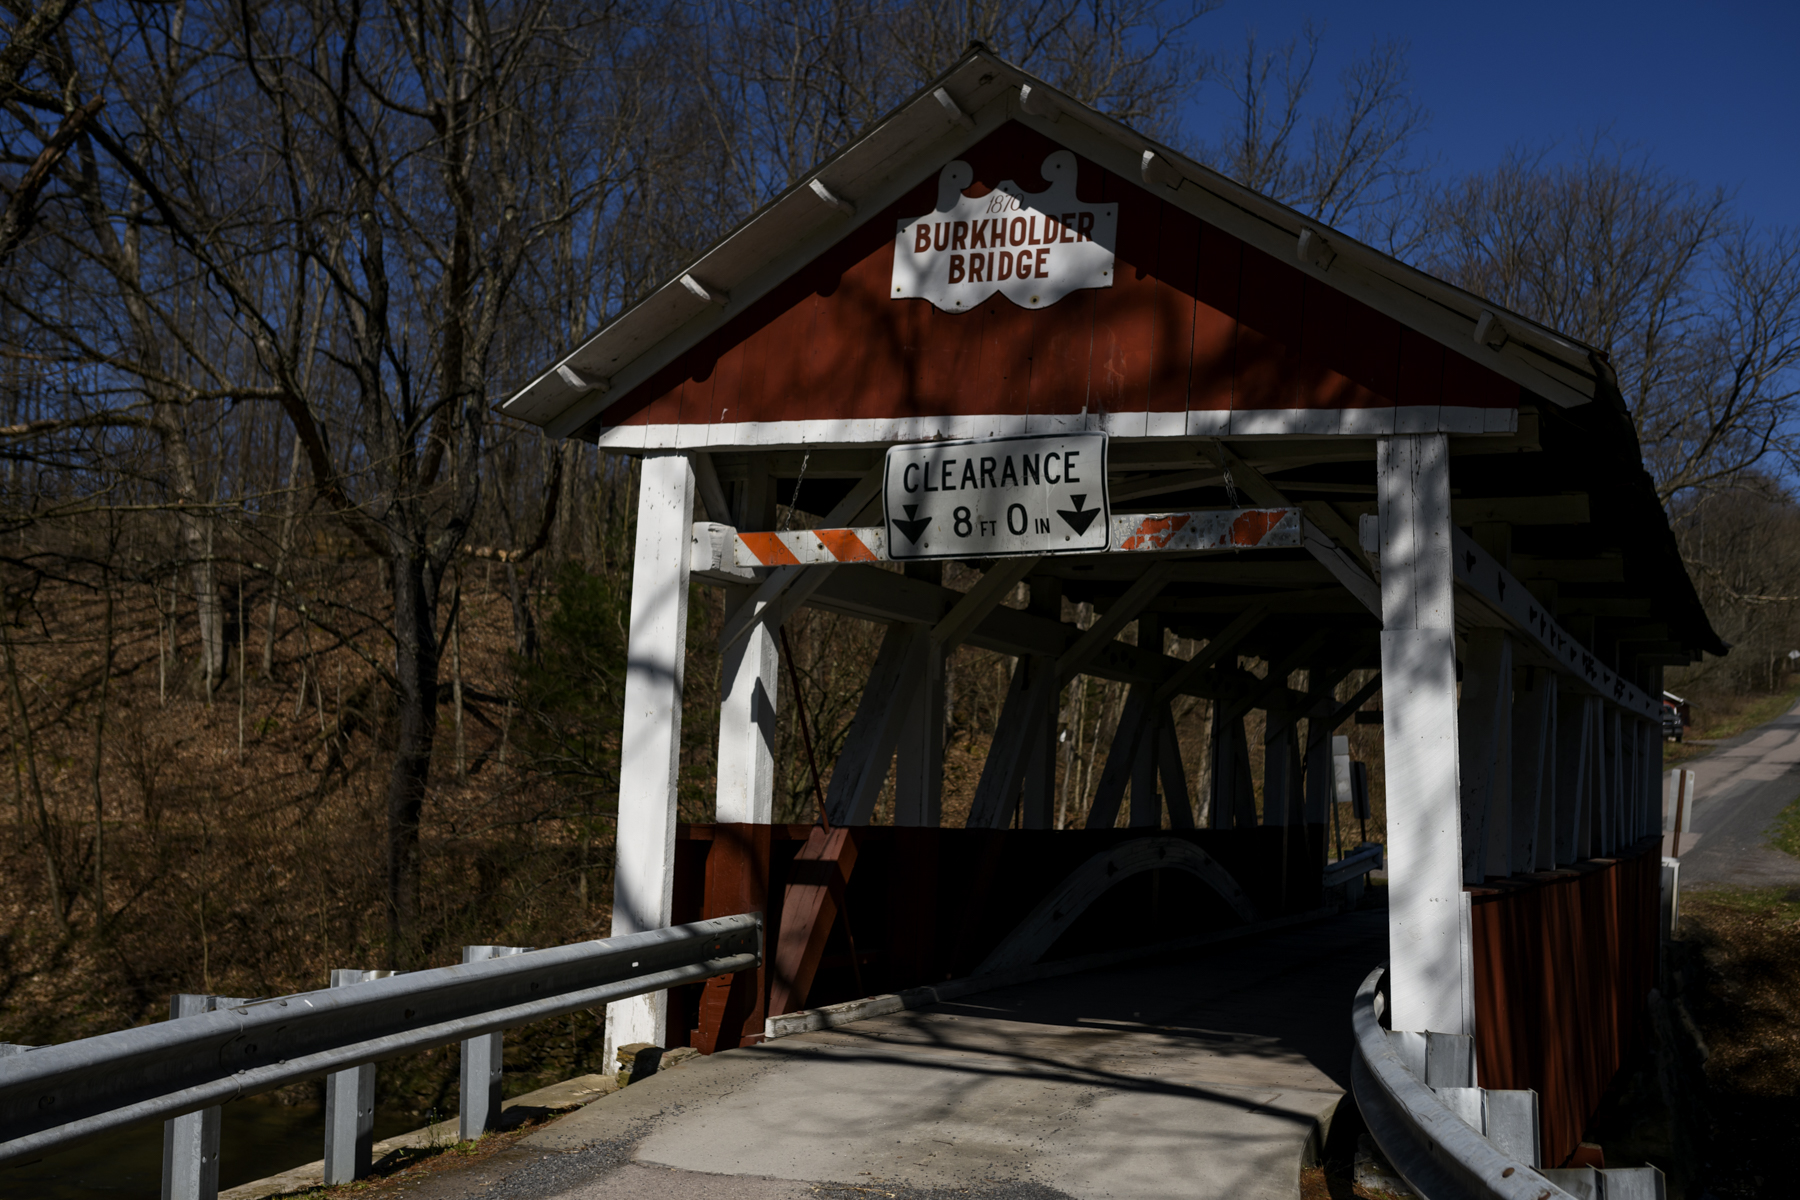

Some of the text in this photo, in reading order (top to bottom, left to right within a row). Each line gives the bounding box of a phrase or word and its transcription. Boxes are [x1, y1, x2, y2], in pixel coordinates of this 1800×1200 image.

[986, 193, 1024, 214] 1870
[914, 212, 1095, 253] BURKHOLDER
[948, 248, 1050, 284] BRIDGE
[903, 451, 1080, 493] CLEARANCE
[953, 503, 1051, 538] 8 FT 0 IN
